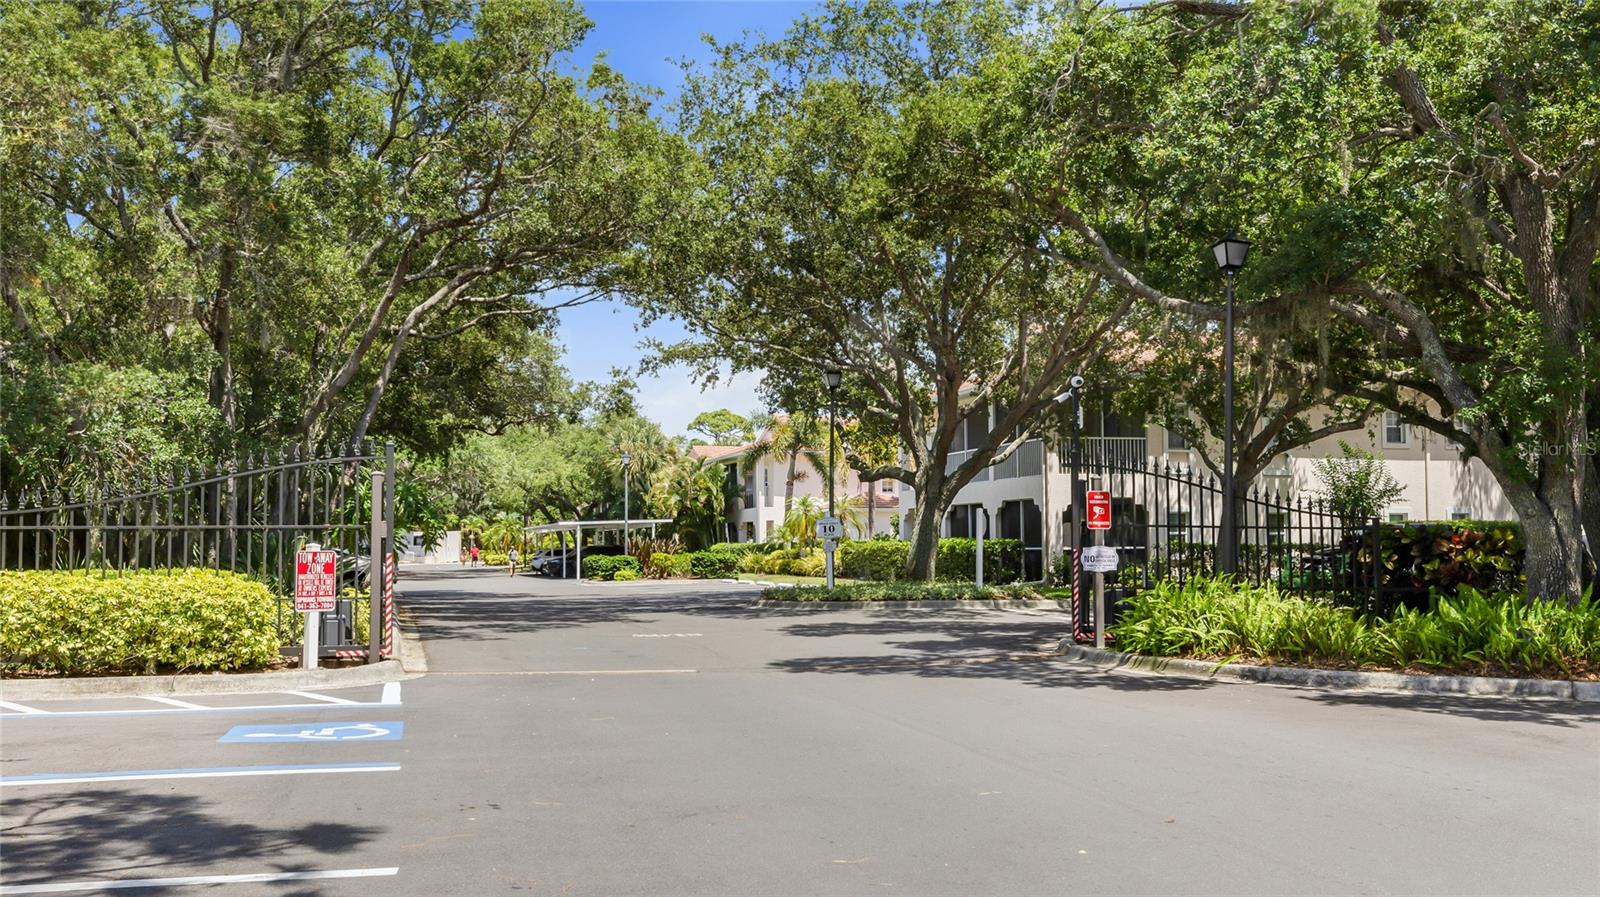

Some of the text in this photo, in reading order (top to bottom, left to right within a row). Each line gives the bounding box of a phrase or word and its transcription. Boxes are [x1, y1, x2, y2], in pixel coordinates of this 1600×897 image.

[823, 525, 835, 533] 10
[1084, 555, 1096, 563] NO
[307, 563, 325, 574] ZONE
